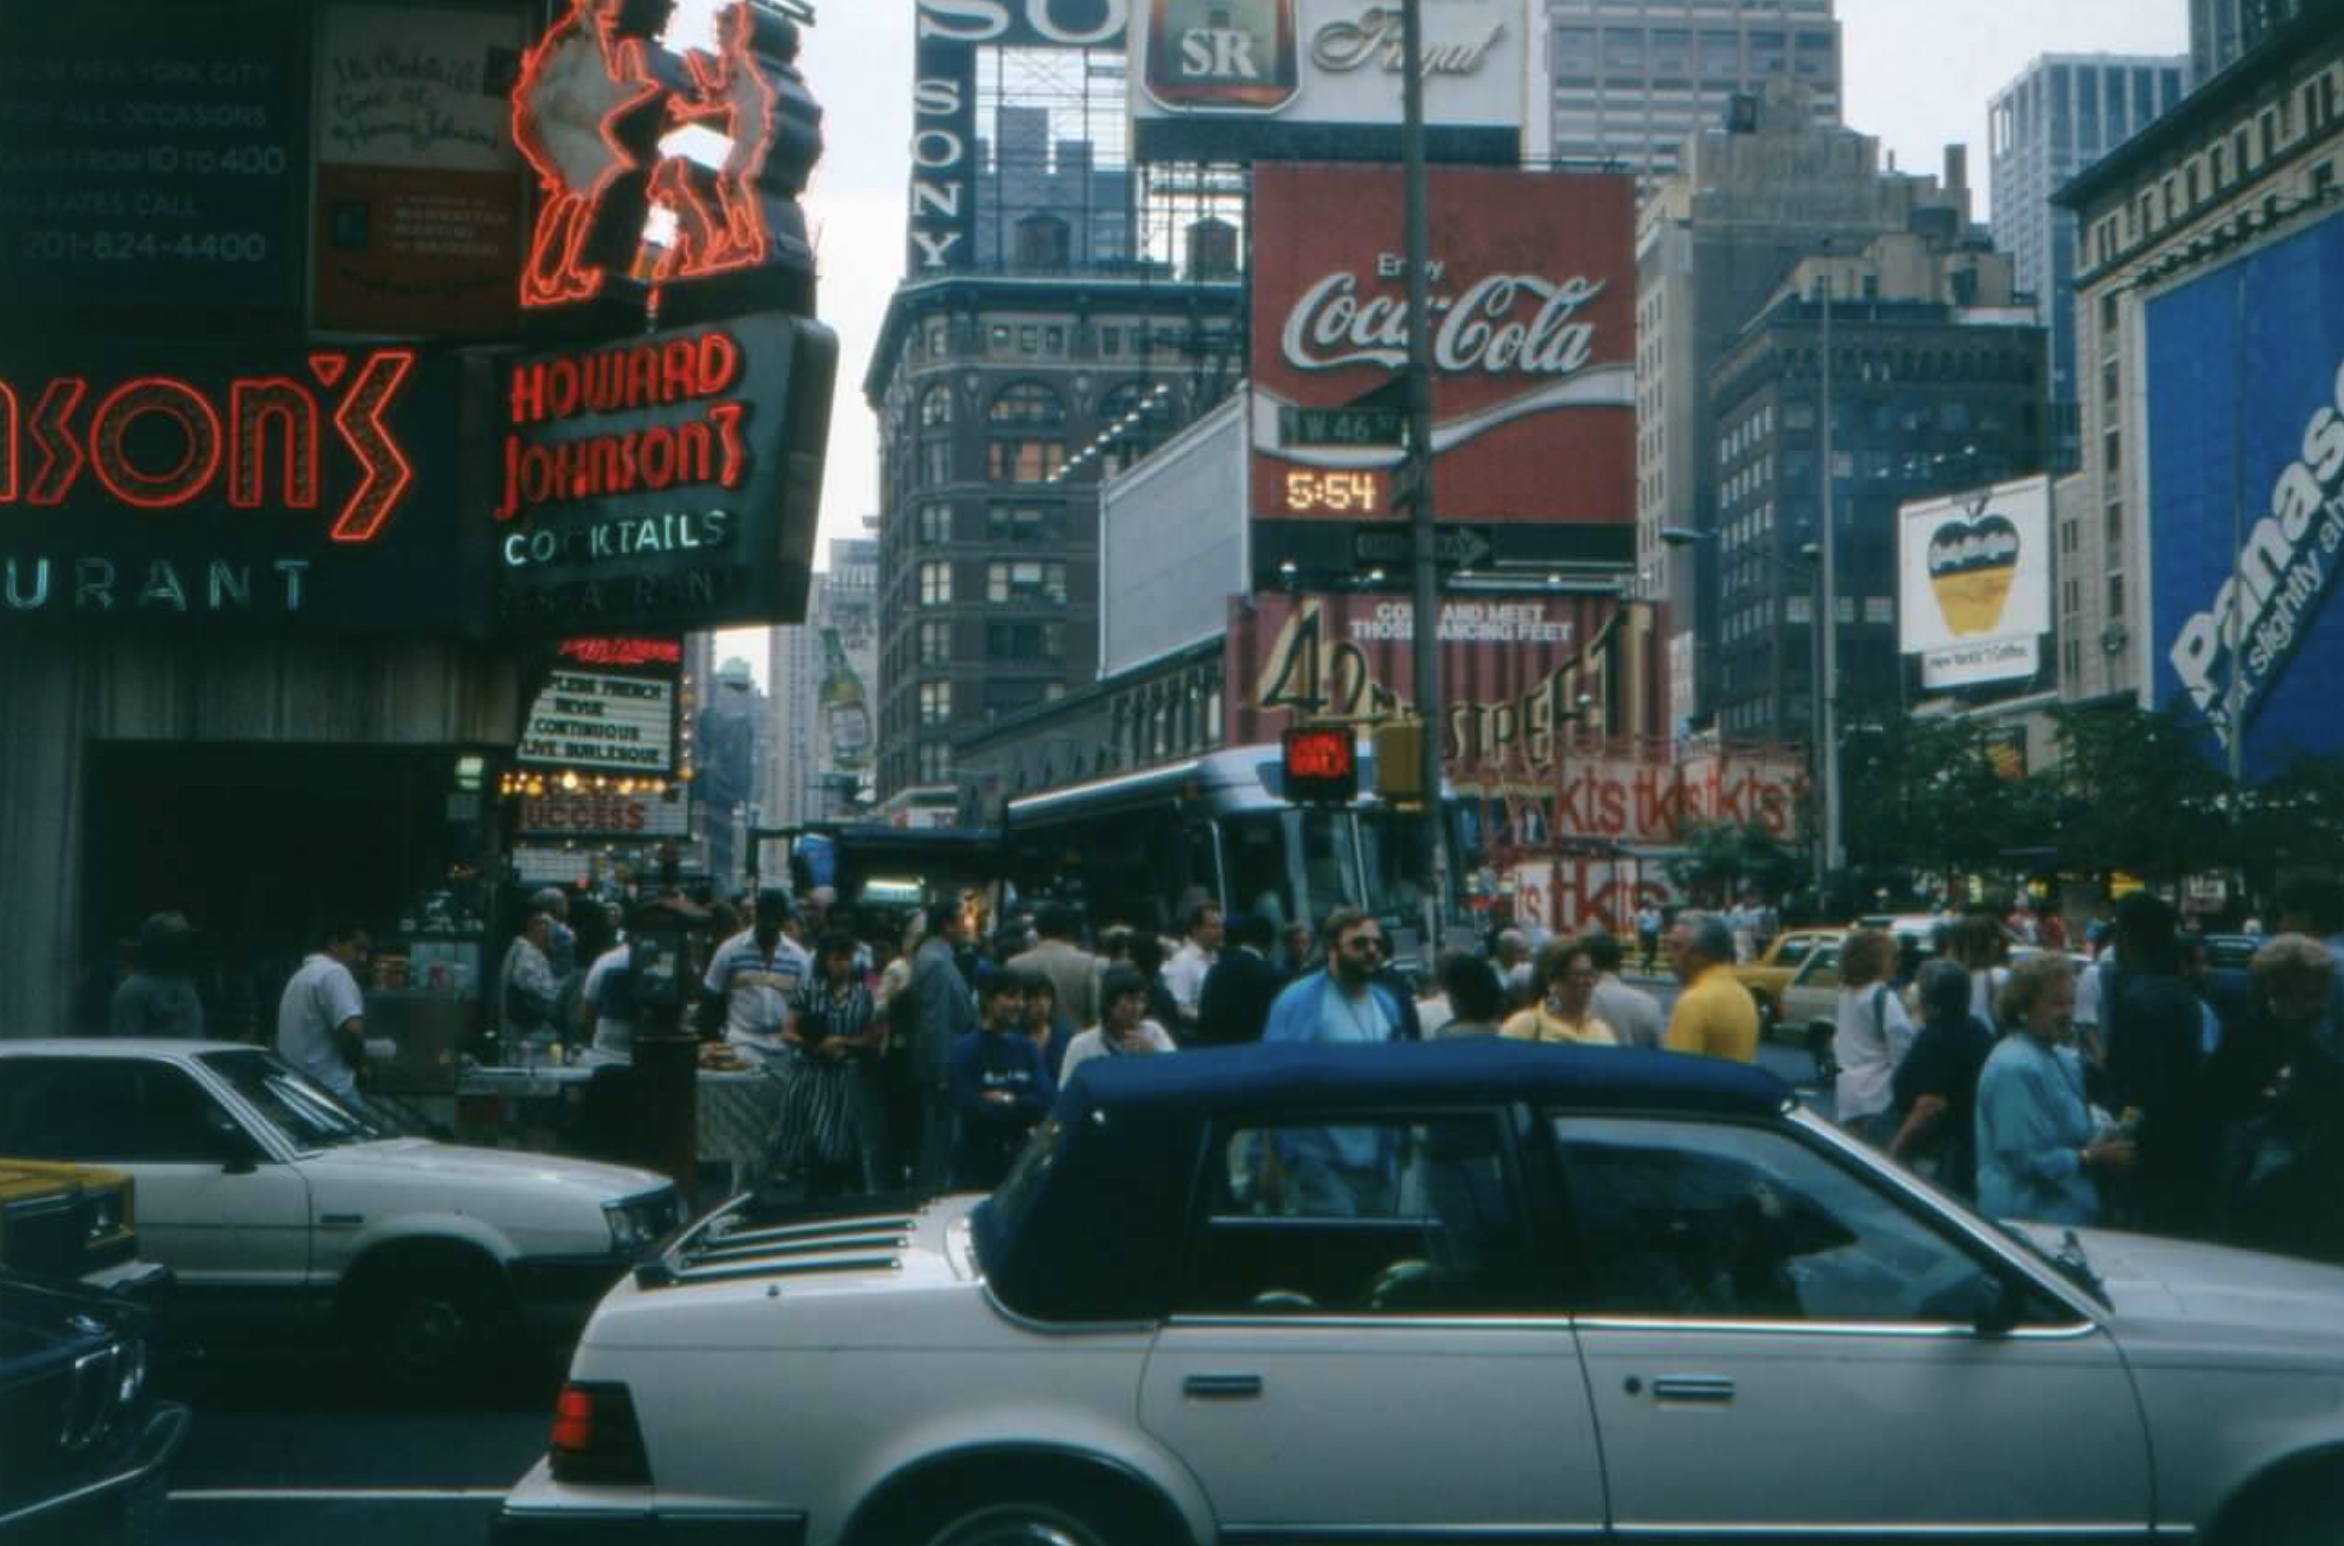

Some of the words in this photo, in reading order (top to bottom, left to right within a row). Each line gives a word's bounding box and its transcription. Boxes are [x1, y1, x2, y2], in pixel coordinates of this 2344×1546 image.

[1182, 28, 1256, 77] SR
[208, 60, 273, 85] CITY
[62, 102, 111, 127] ALL
[120, 102, 267, 129] OCCASIONS
[147, 145, 178, 174] 10
[220, 144, 286, 175] 400
[909, 78, 964, 267] SONY
[134, 190, 198, 217] CALL
[1378, 252, 1445, 281] Eny
[511, 332, 739, 424] HOWARD
[1305, 415, 1328, 441] W
[1333, 414, 1371, 442] 46
[1286, 471, 1377, 511] 5:54
[503, 508, 728, 568] COKTAILS
[2168, 360, 2344, 712] Panas
[5, 556, 311, 611] URANT
[1487, 602, 1548, 622] MEET
[2250, 549, 2324, 677] slightly
[1436, 621, 1517, 640] ANCING
[1517, 622, 1574, 640] FEET
[535, 718, 640, 742] CONTINUOUS
[565, 742, 659, 765] BURLESQUE
